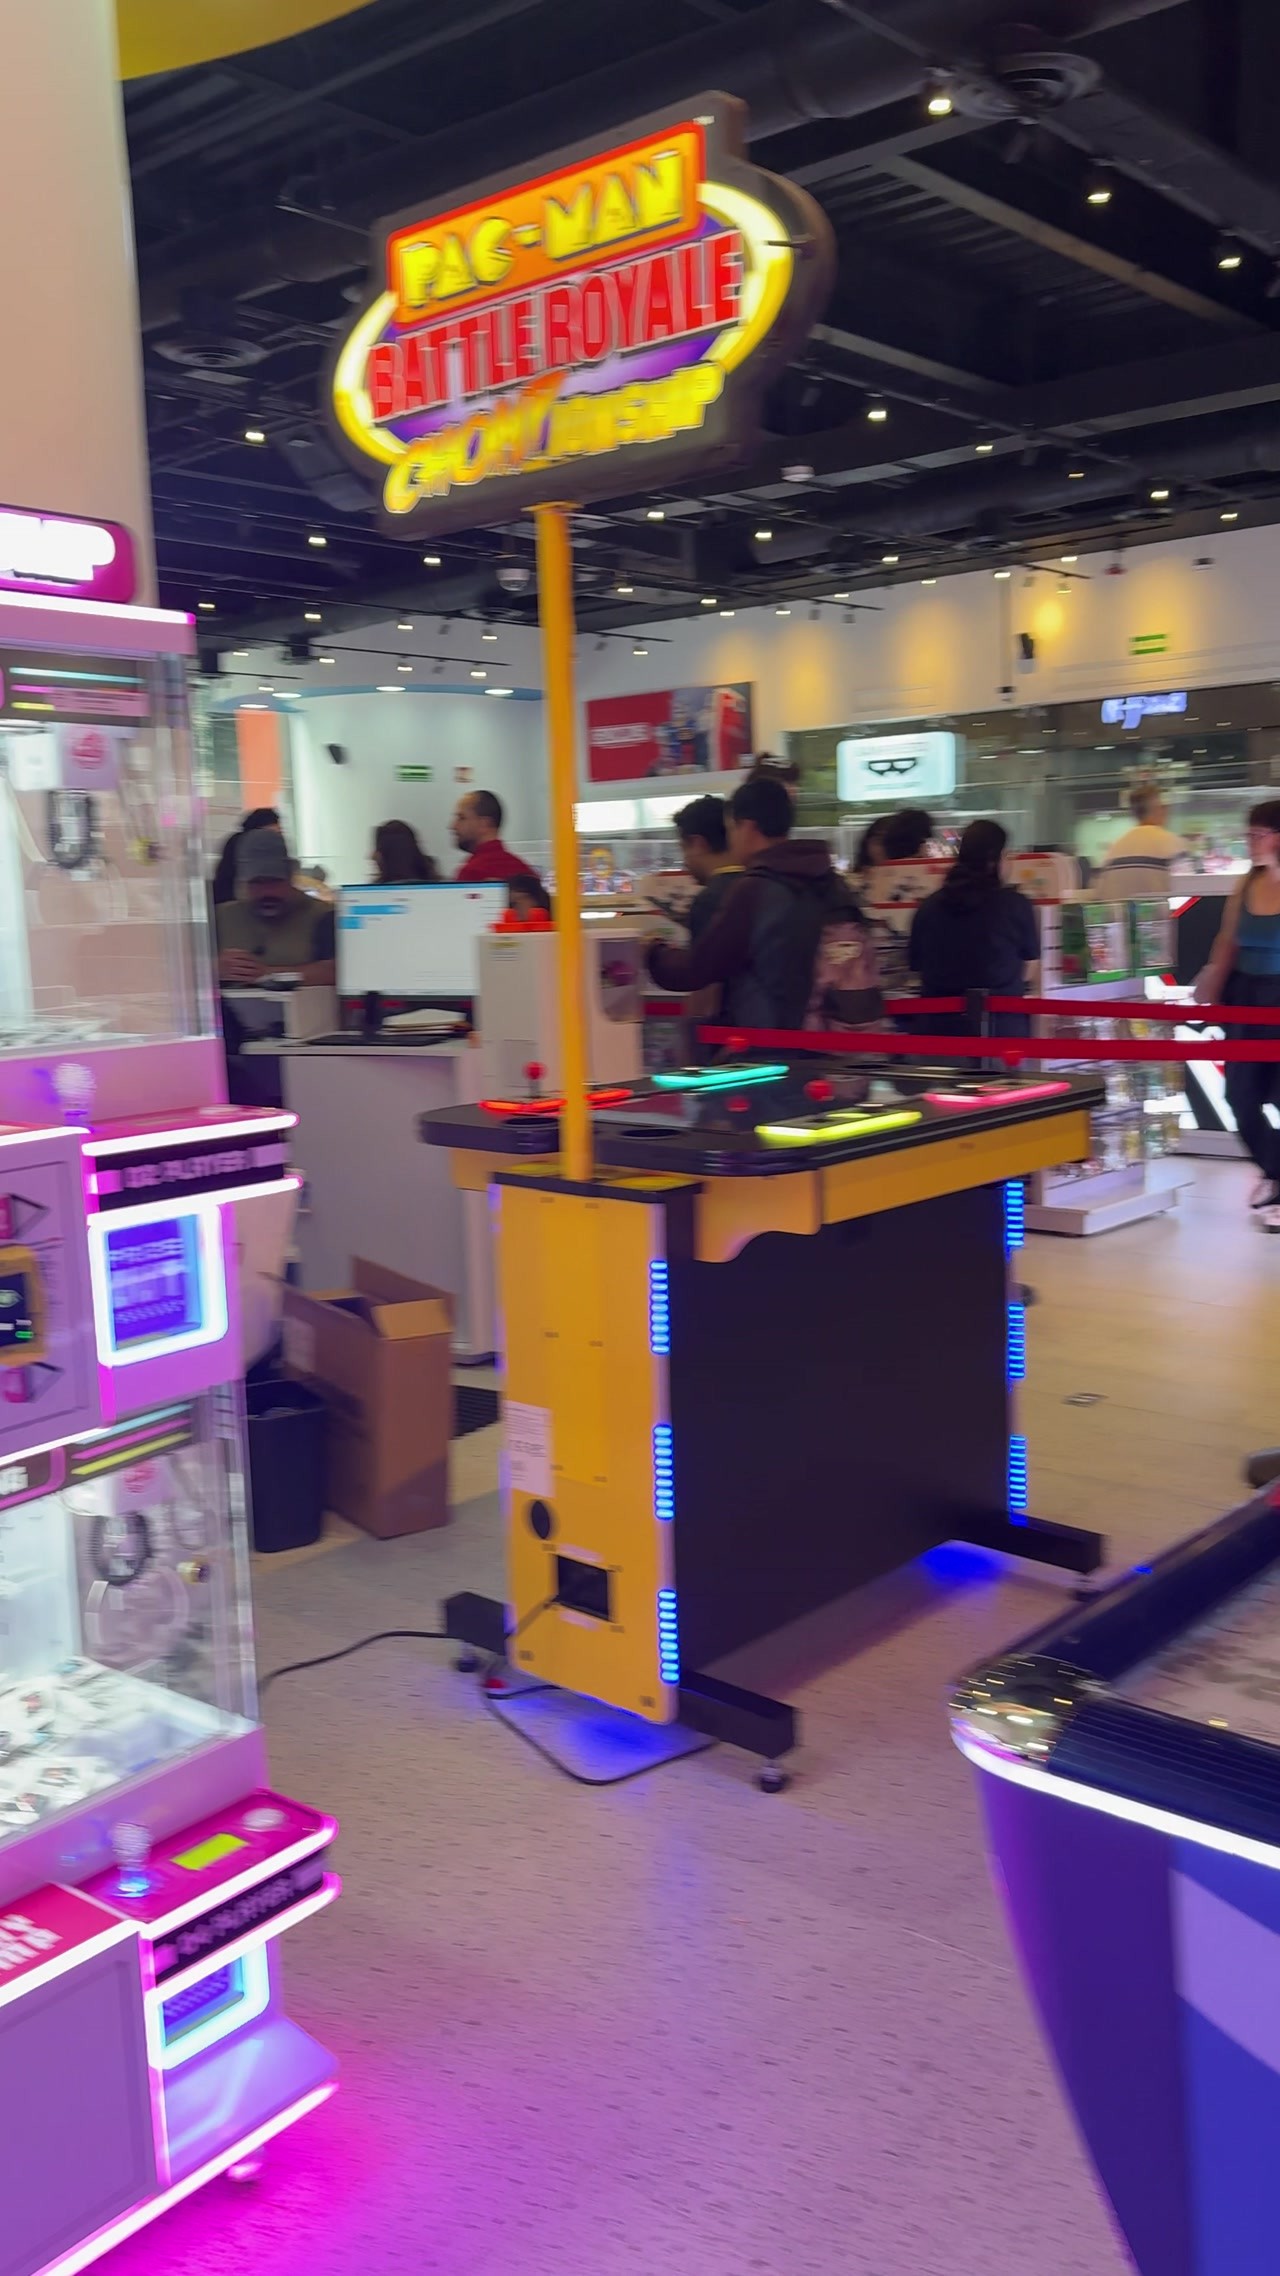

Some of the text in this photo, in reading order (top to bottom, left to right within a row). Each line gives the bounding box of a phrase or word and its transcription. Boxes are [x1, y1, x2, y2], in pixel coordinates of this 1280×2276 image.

[399, 149, 684, 308] PAC-MAN
[368, 230, 743, 424] BATTLE ROYALE
